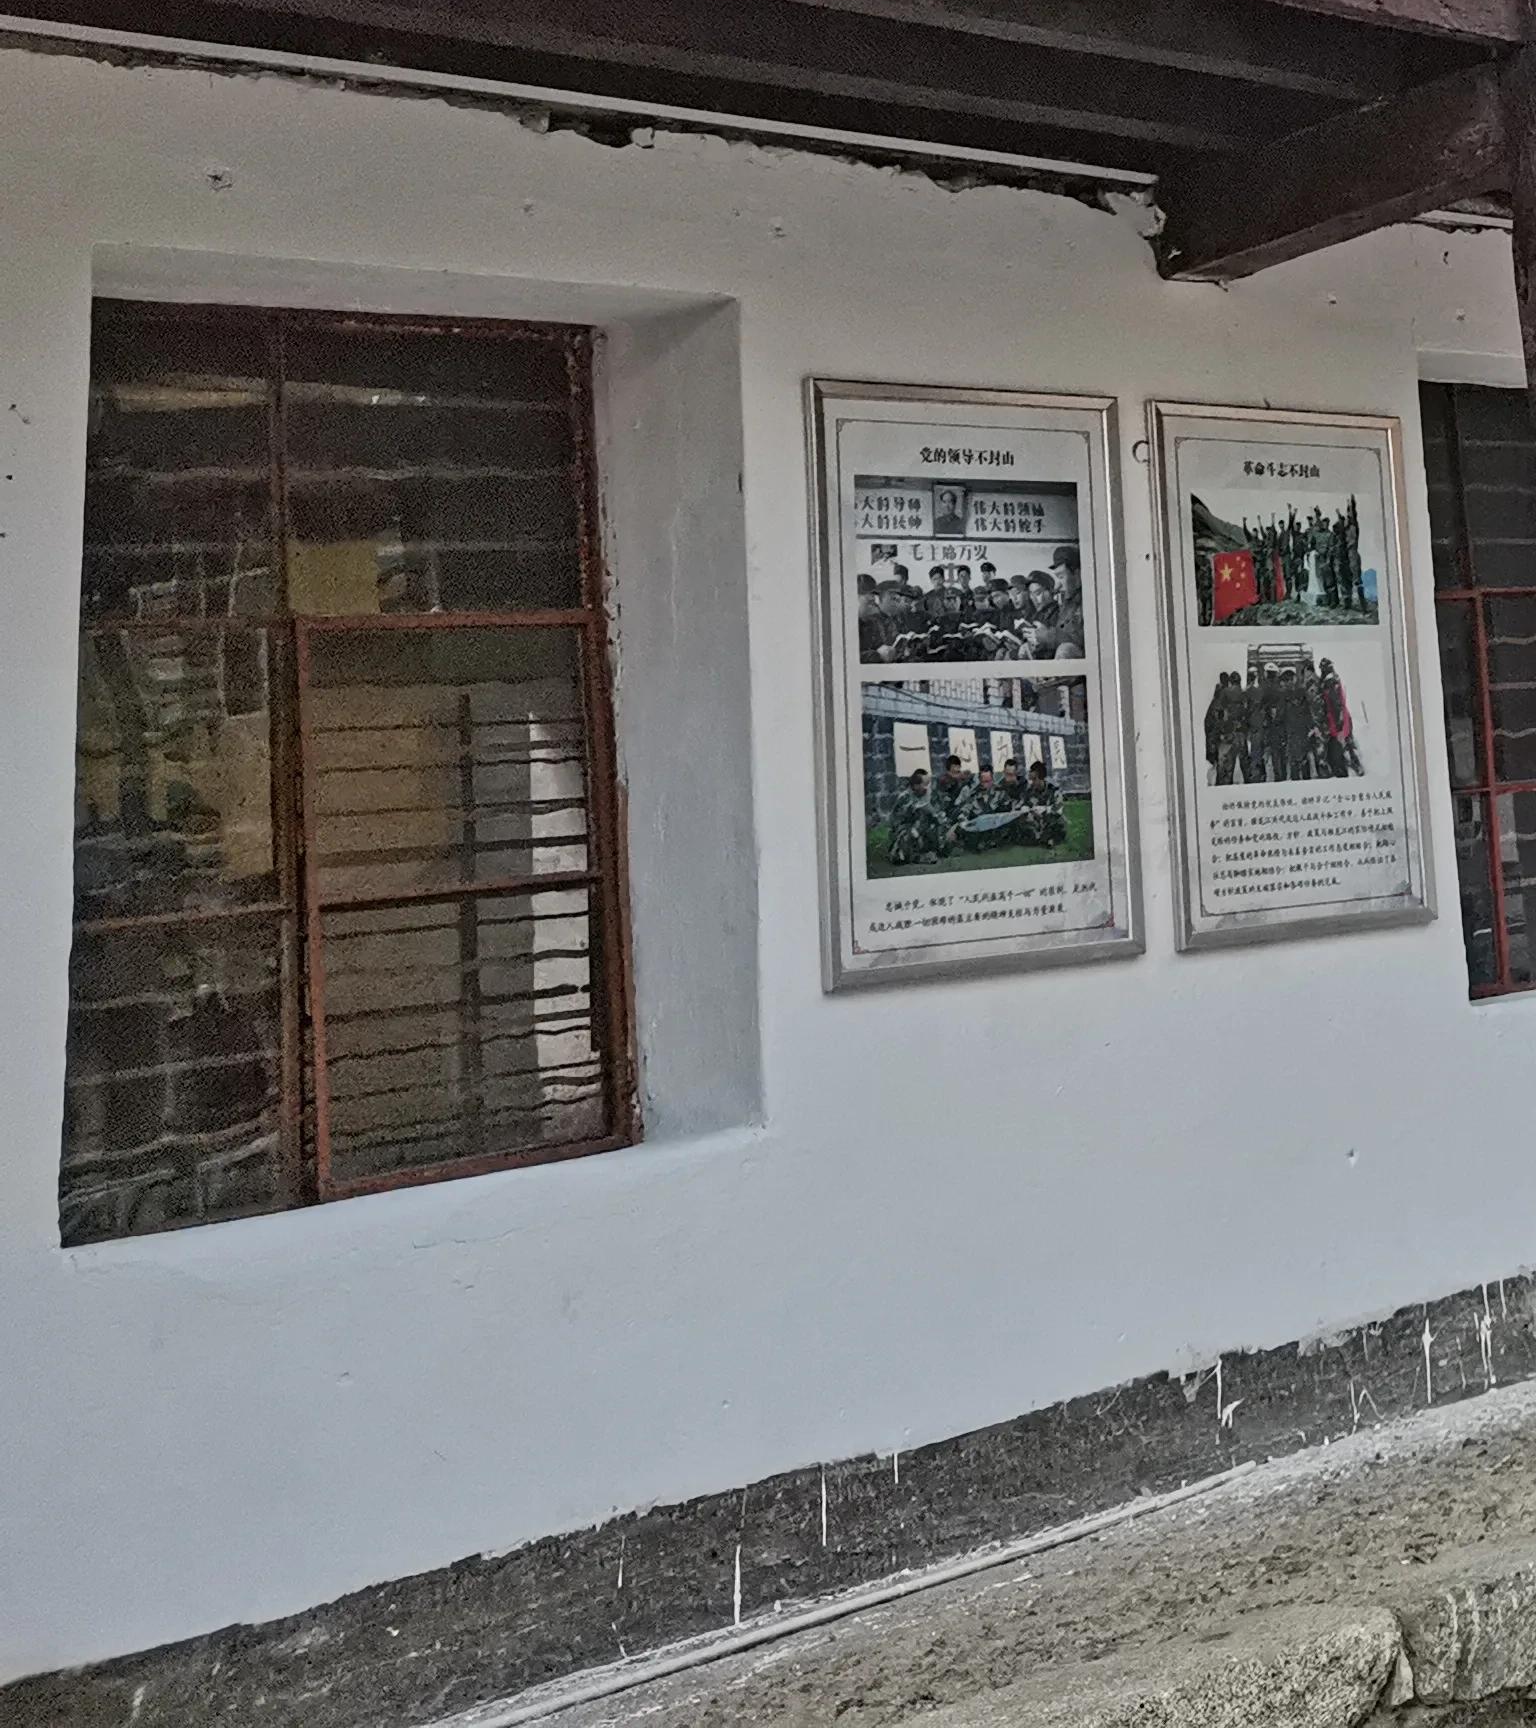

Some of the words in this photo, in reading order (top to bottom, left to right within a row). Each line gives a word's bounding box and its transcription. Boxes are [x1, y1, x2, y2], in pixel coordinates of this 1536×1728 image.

[919, 445, 1016, 467] 党的领导不封山
[1243, 459, 1321, 480] 革命斗志不封山
[853, 495, 922, 513] 大的导师
[910, 543, 988, 562] 毛主席万岁
